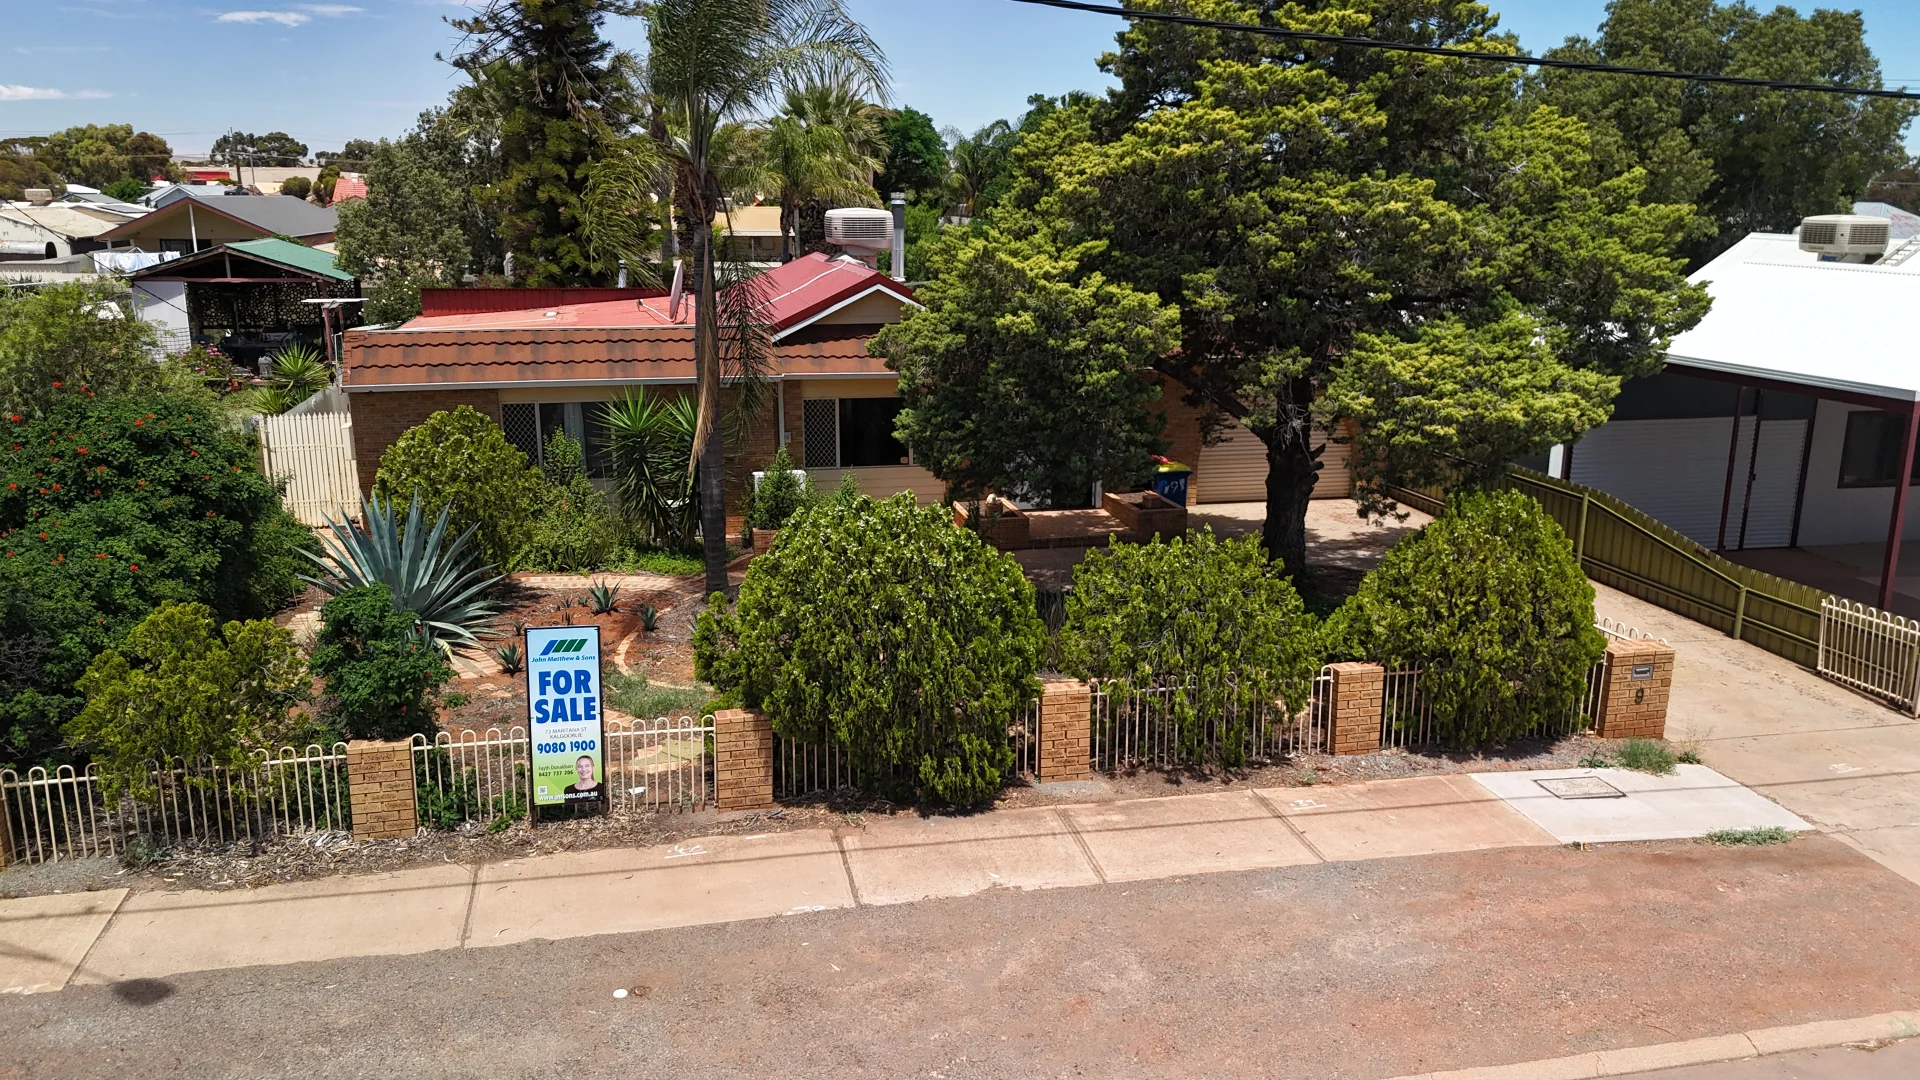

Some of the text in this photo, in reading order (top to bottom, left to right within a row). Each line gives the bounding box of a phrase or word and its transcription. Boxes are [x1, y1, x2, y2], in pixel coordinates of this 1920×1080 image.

[539, 670, 591, 695] FOR
[1635, 687, 1644, 705] 9
[534, 697, 596, 724] SALE
[537, 740, 596, 754] 9080 1900
[539, 791, 597, 801] www.jmsons.com.au
